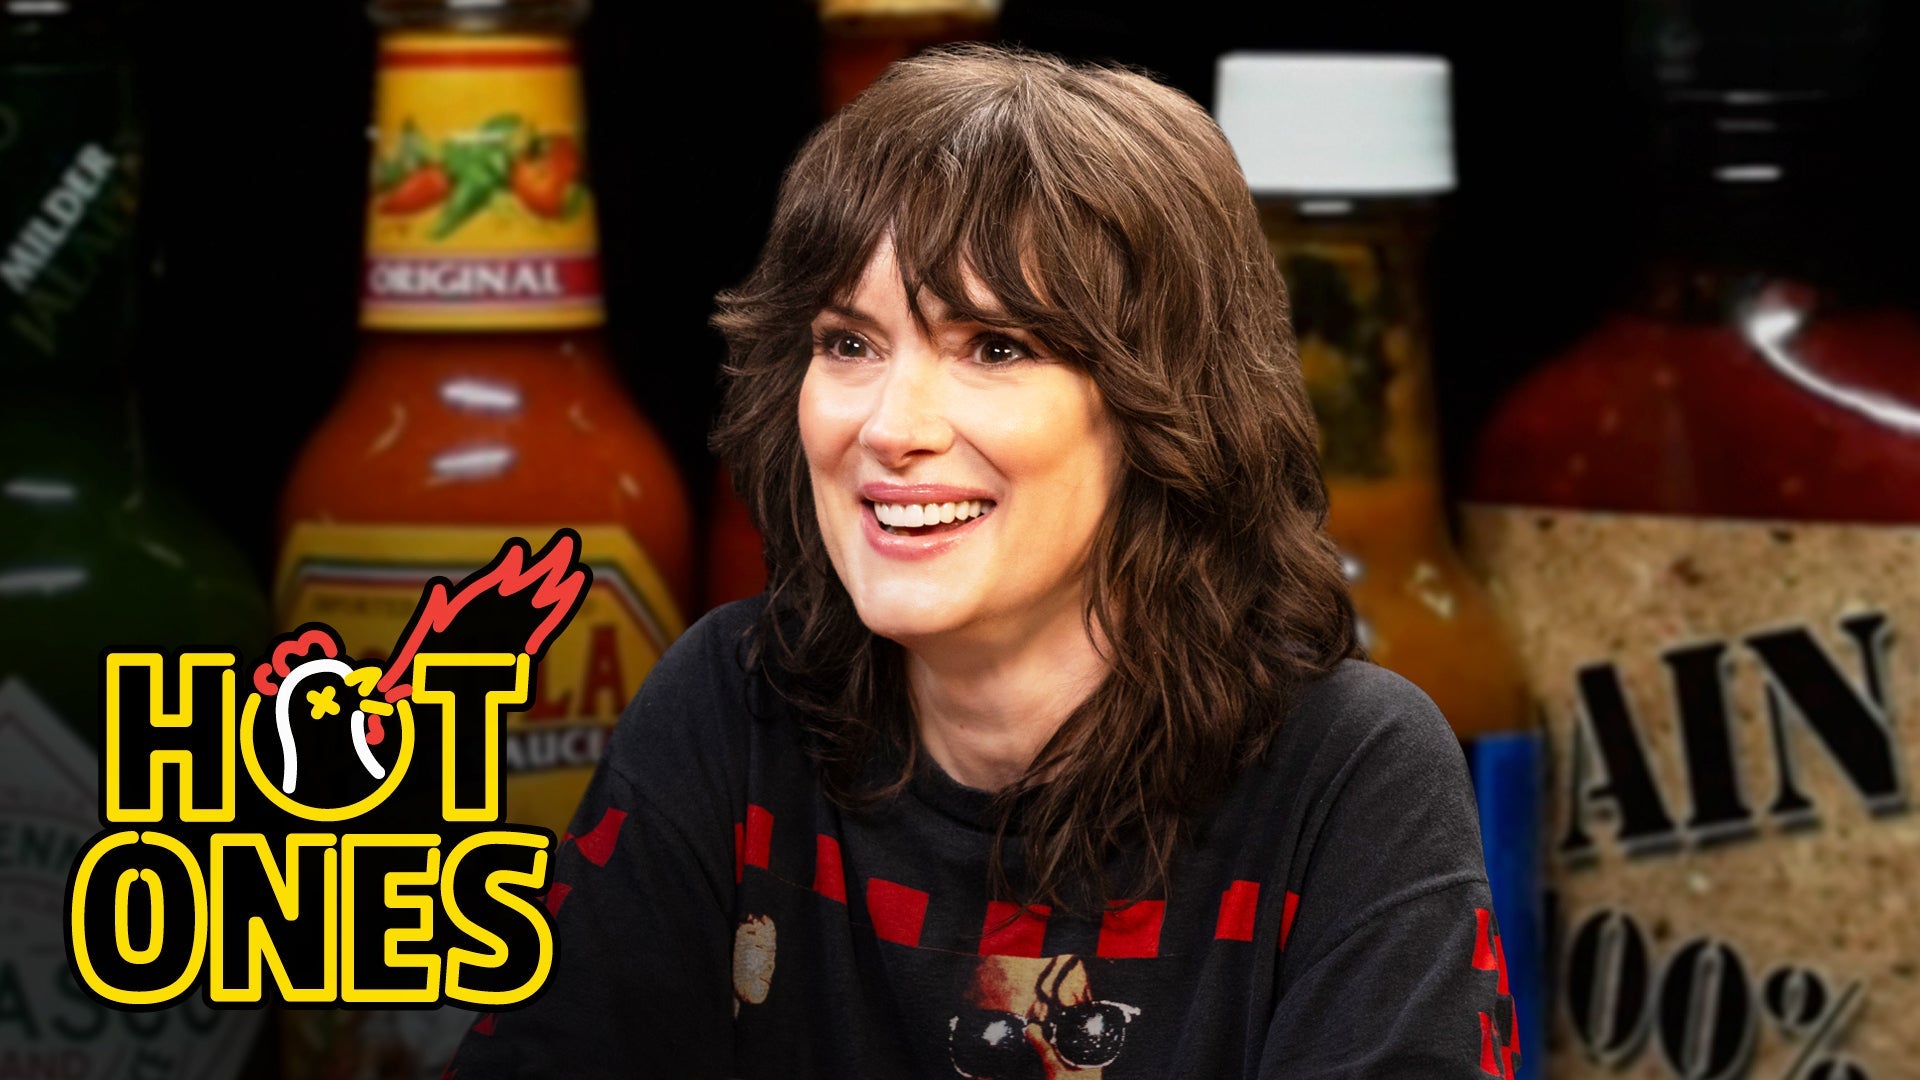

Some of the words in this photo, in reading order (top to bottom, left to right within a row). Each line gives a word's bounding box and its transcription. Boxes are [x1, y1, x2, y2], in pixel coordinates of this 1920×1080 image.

[0, 141, 117, 296] MILDER
[368, 262, 563, 296] ORIGINAL
[1548, 890, 1875, 1080] 00%
